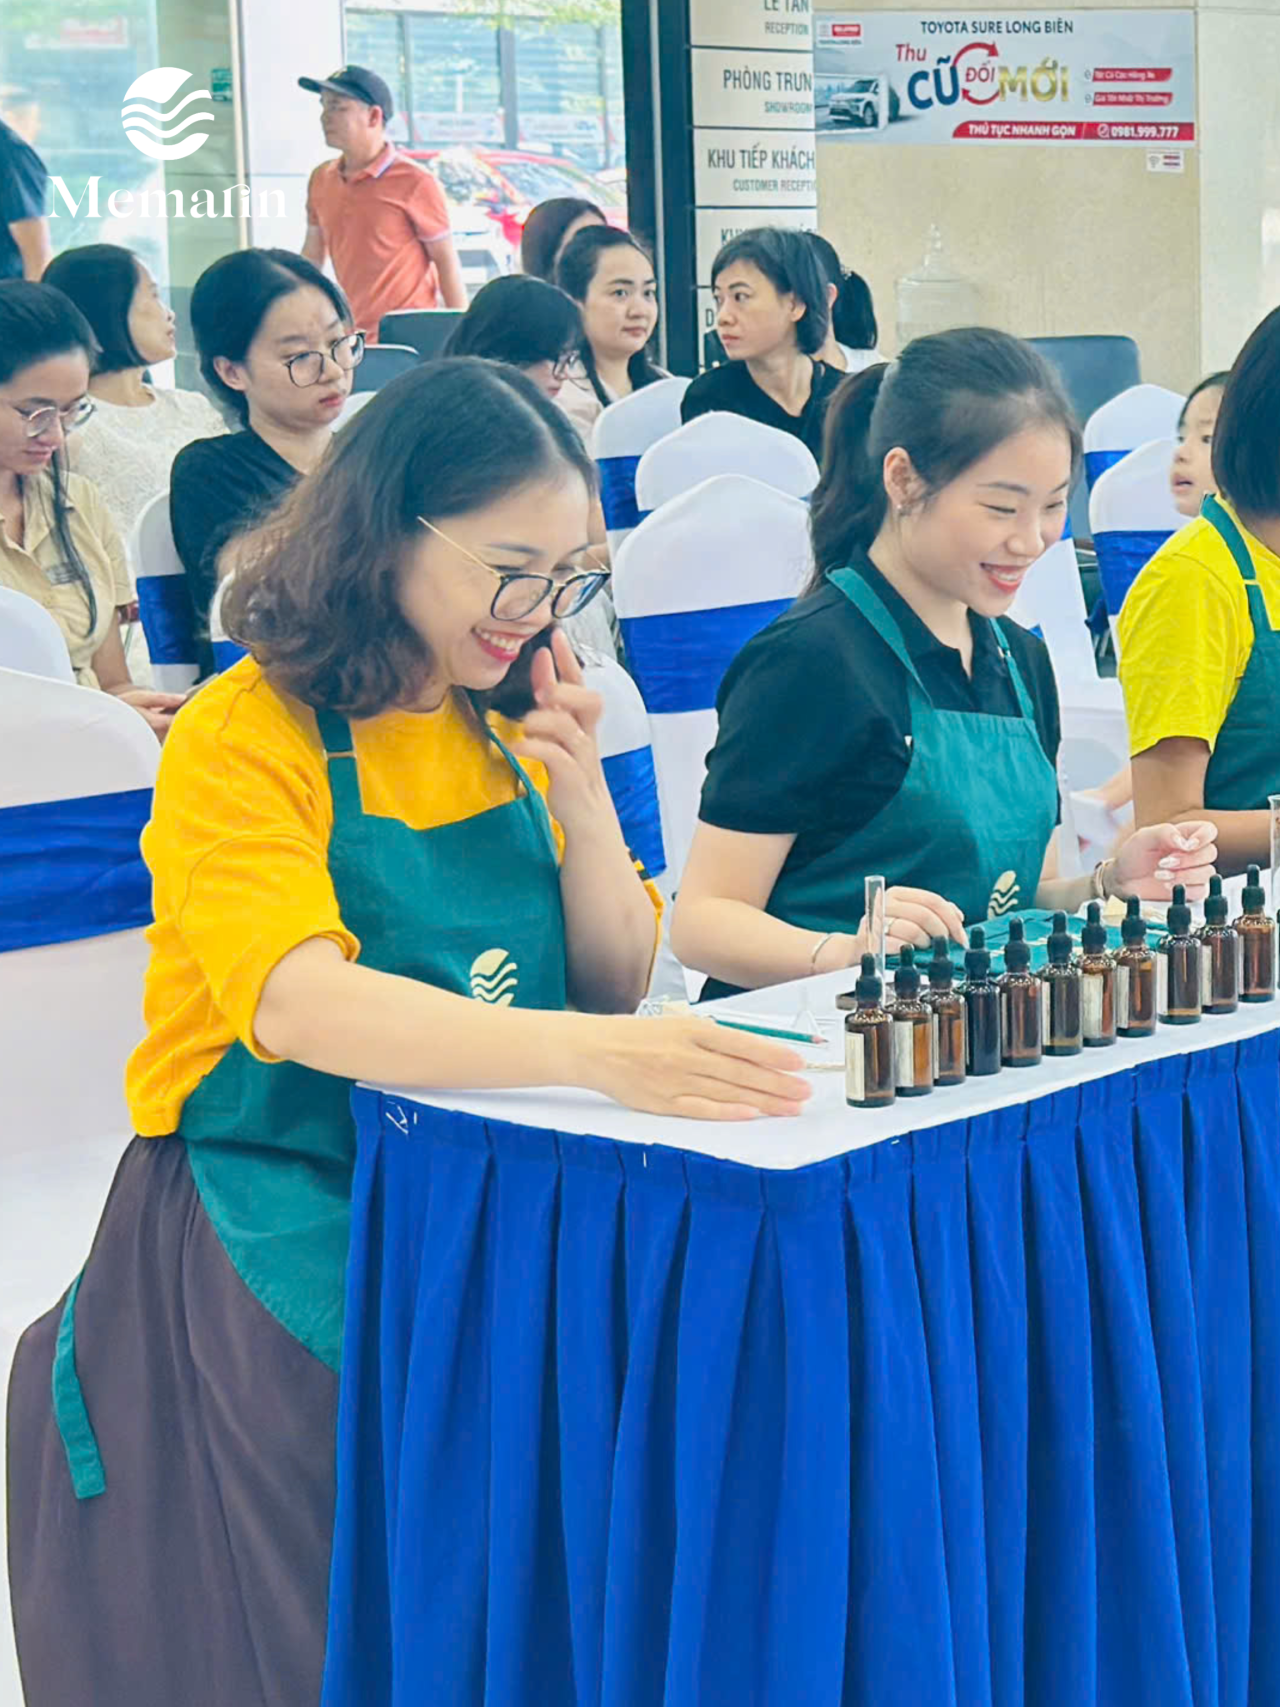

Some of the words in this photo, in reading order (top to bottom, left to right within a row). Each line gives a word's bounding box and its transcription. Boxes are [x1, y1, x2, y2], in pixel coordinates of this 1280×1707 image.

[764, 21, 809, 35] RECEPTION
[921, 21, 969, 34] TOYOTA
[972, 21, 1003, 34] SURE
[1006, 20, 1041, 34] LONG
[1045, 17, 1073, 34] BIÊN
[896, 43, 927, 62] Thu
[723, 65, 772, 90] PHÒNG
[907, 55, 960, 110] CŨ
[998, 56, 1070, 102] MỚI
[969, 121, 989, 136] THỦ
[991, 124, 1010, 138] TỤC
[1012, 124, 1049, 136] NHANH
[1051, 125, 1076, 138] GỌN
[1111, 126, 1179, 138] 0981.999.777
[708, 149, 735, 169] KHU
[740, 142, 767, 169] TIẾP
[772, 146, 815, 169] KHÁCH
[733, 179, 778, 192] CUSTOMER
